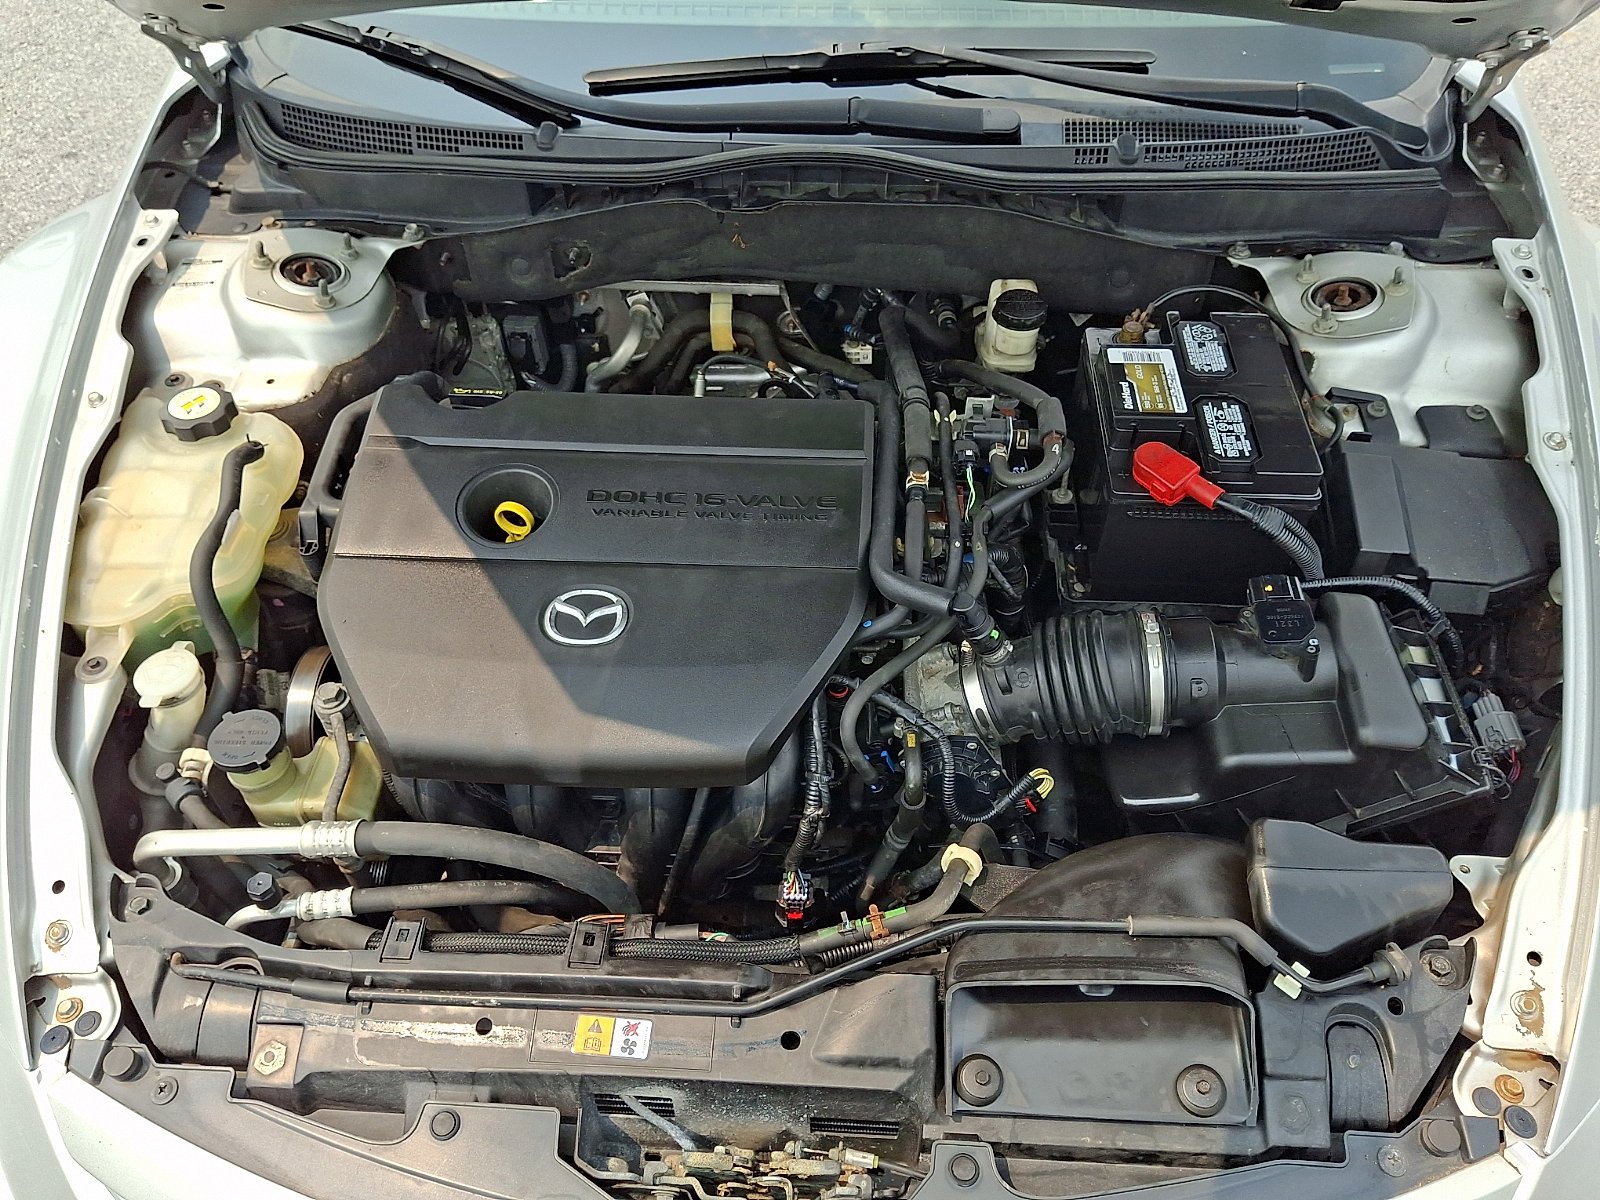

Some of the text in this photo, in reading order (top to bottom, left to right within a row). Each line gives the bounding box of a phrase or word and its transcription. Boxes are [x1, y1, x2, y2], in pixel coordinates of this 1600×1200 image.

[1119, 381, 1134, 410] DieHard
[1051, 443, 1060, 455] 4
[586, 489, 837, 511] DOHC 16-VALVE
[591, 507, 829, 522] VARIABLE VALVE TIMING
